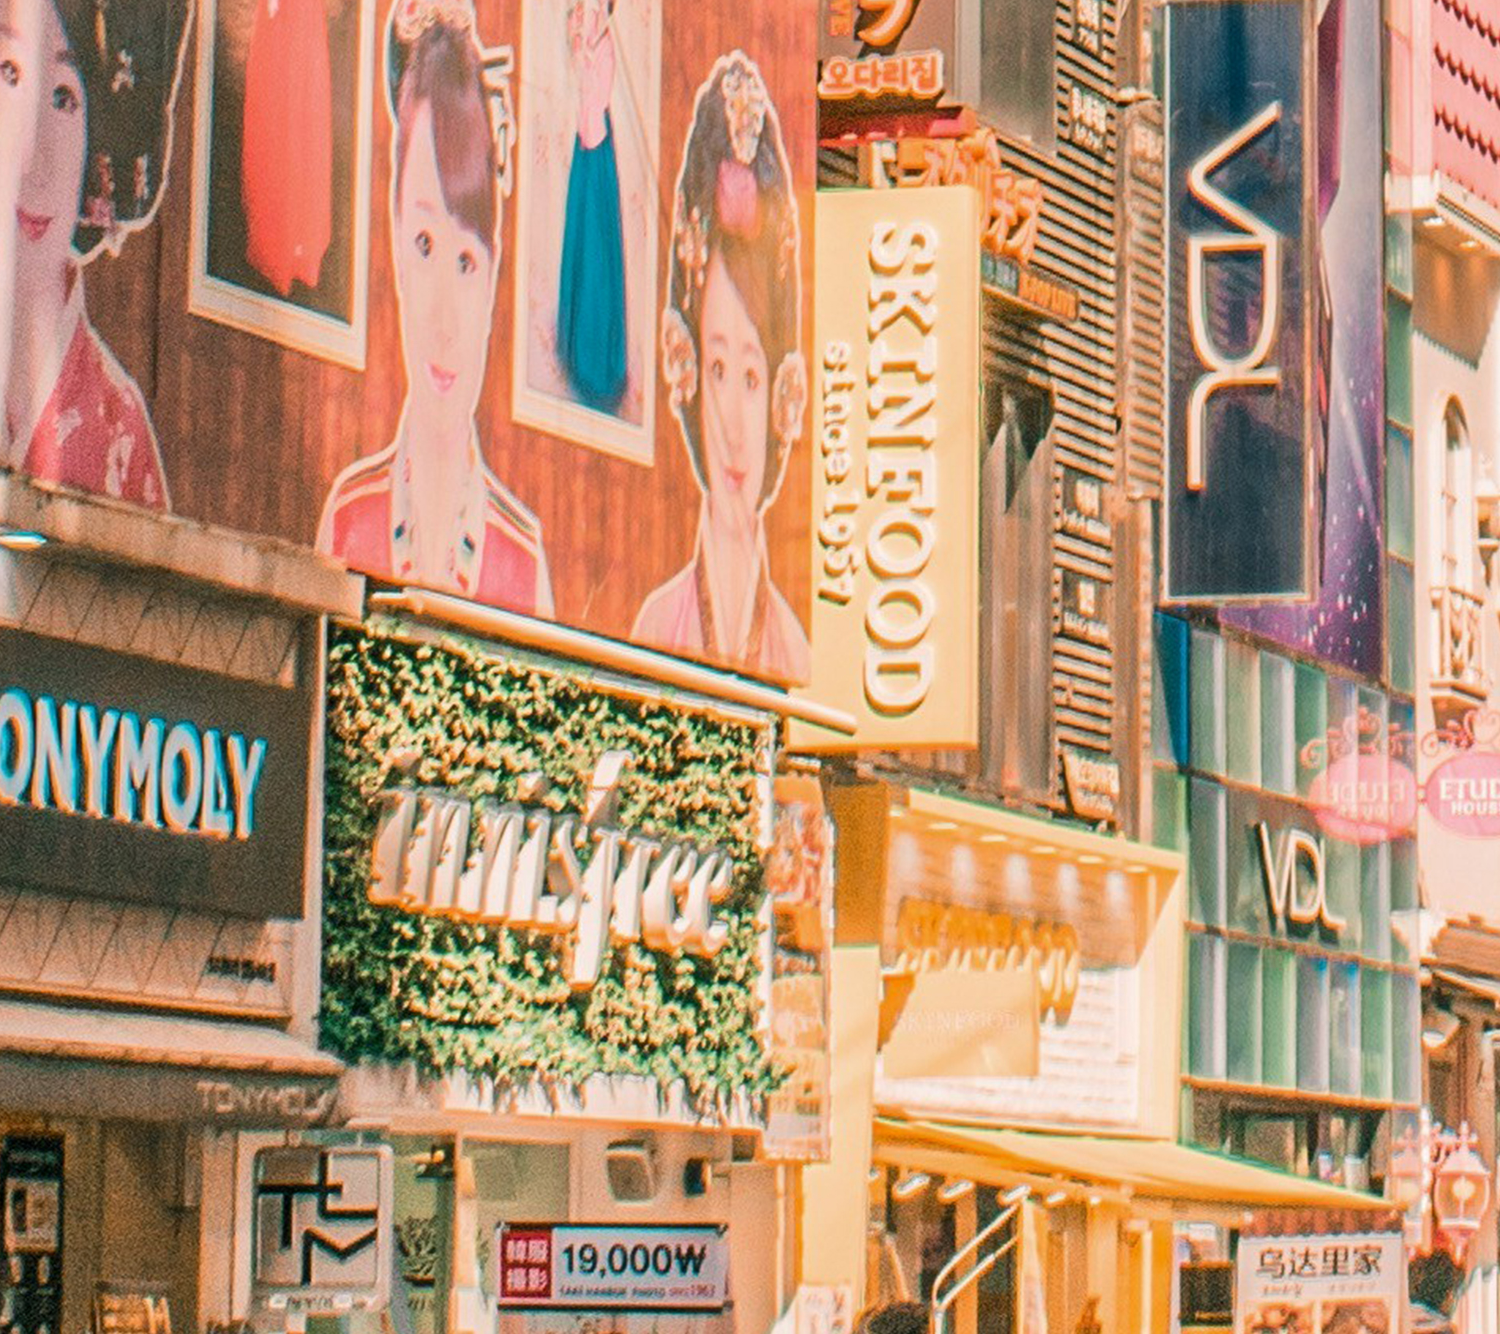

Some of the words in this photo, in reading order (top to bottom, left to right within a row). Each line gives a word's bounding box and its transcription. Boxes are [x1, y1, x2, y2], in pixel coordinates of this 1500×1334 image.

[822, 53, 941, 95] 오다리집
[1186, 100, 1282, 494] VDL
[822, 338, 853, 486] since
[862, 219, 940, 717] SKINFOOD
[366, 748, 736, 995] innisfree
[1258, 820, 1347, 935] VDL
[1255, 1243, 1384, 1280] 乌达里家
